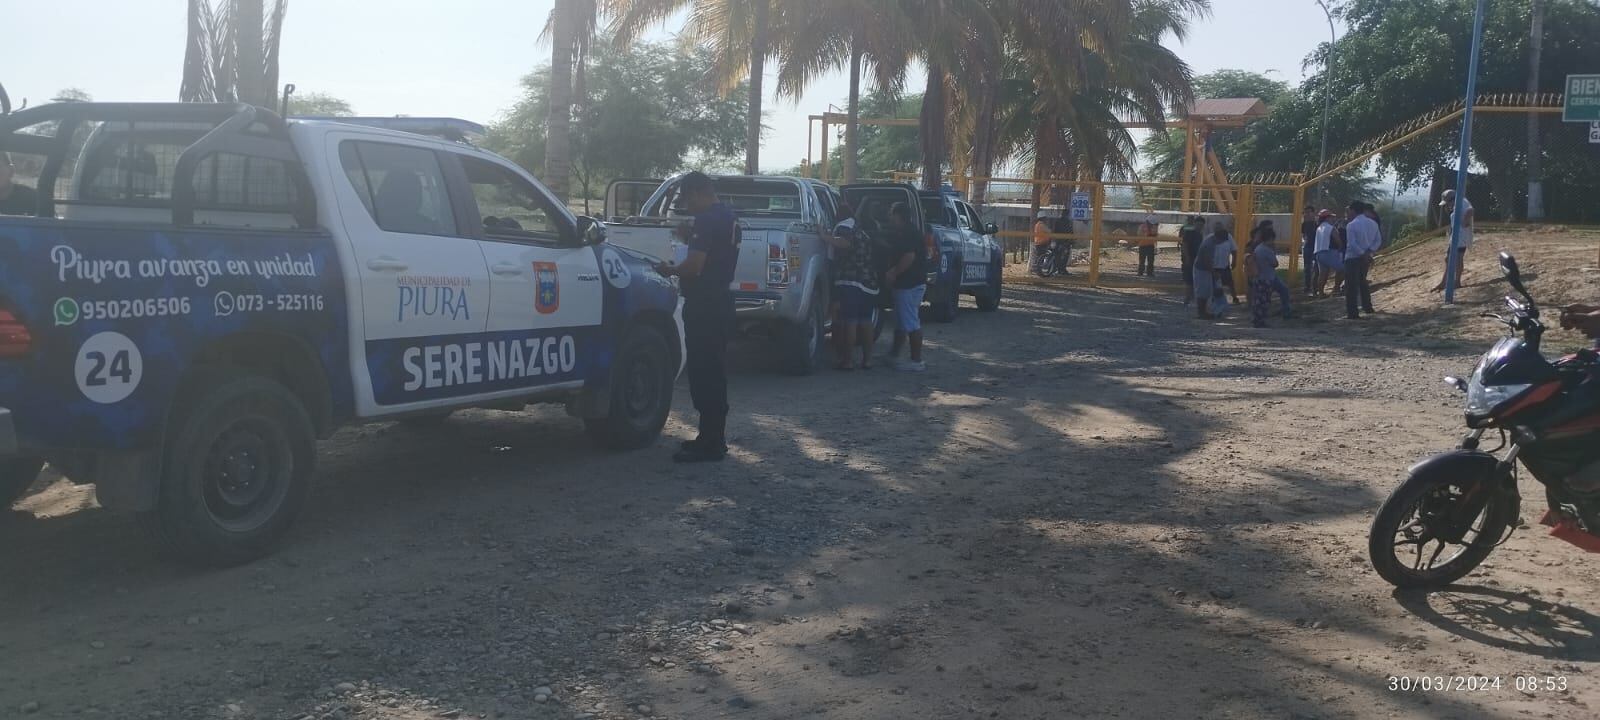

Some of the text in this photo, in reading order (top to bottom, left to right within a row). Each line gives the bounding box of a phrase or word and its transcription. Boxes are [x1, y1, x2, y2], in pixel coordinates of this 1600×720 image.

[51, 245, 317, 287] Piura avanza en unidad
[604, 258, 628, 279] 24
[83, 297, 191, 319] 950206506
[237, 294, 264, 311] 073
[277, 294, 324, 311] 525116
[398, 286, 470, 322] PIURA
[85, 350, 132, 387] 24
